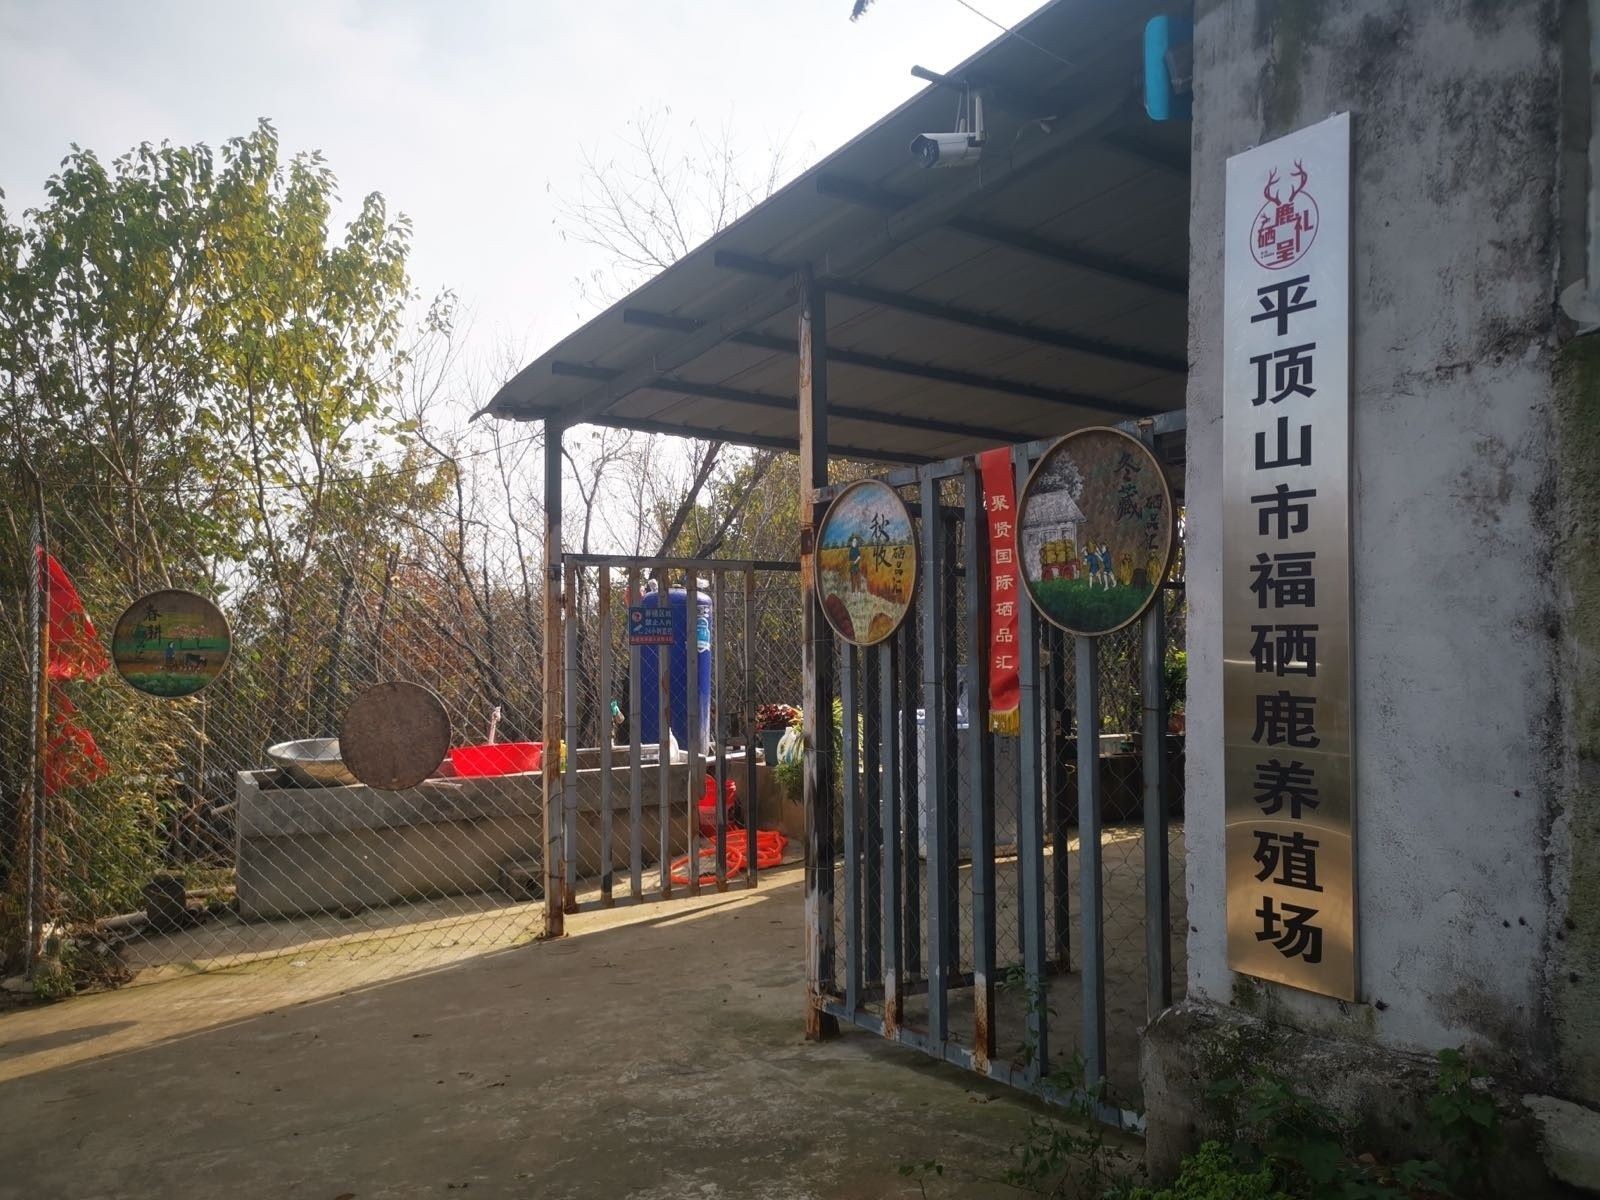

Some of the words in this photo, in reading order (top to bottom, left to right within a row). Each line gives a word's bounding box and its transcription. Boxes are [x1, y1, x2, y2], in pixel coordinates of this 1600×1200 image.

[869, 512, 892, 573] 秋收
[990, 494, 1015, 670] 聚贤国际硒品汇
[1250, 274, 1324, 964] 平顶山市福硒鹿养殖场
